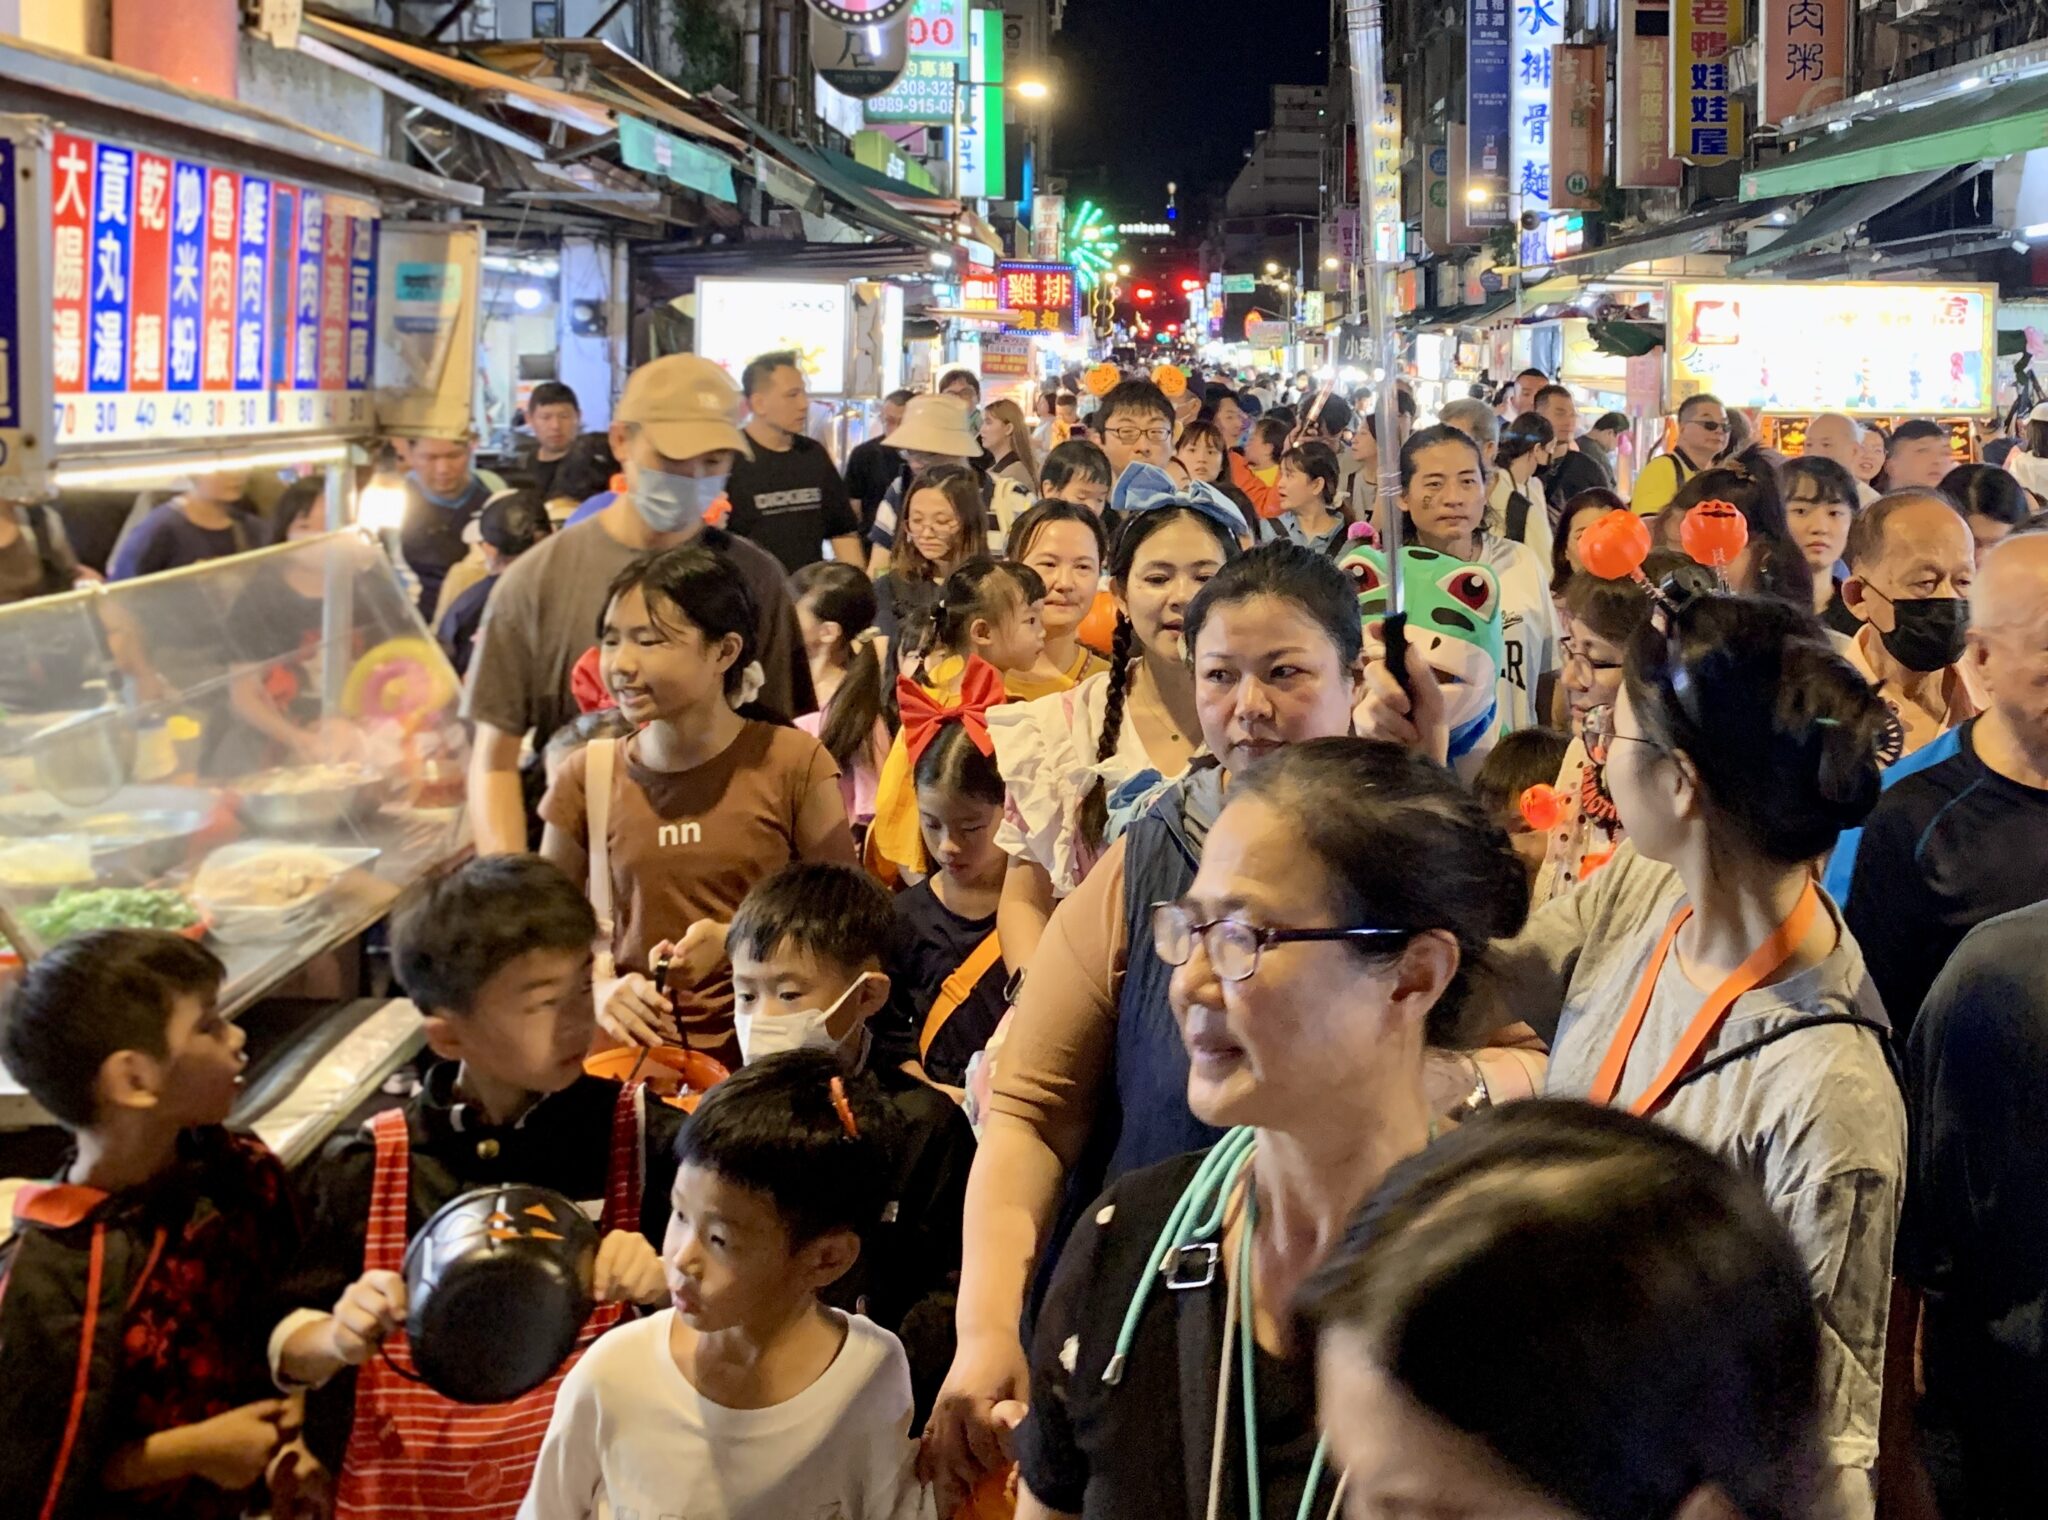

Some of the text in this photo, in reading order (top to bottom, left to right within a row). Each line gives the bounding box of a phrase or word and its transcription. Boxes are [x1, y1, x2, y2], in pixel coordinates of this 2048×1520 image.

[1786, 0, 1824, 82] 肉粥
[53, 142, 88, 382] 大腸湯
[93, 151, 129, 382] 貢丸湯
[171, 165, 202, 382] 炒米粉
[1008, 273, 1071, 306] 雞排
[95, 402, 116, 432] 30
[135, 397, 157, 429] 40
[172, 397, 192, 427] 40
[658, 822, 702, 847] nn
